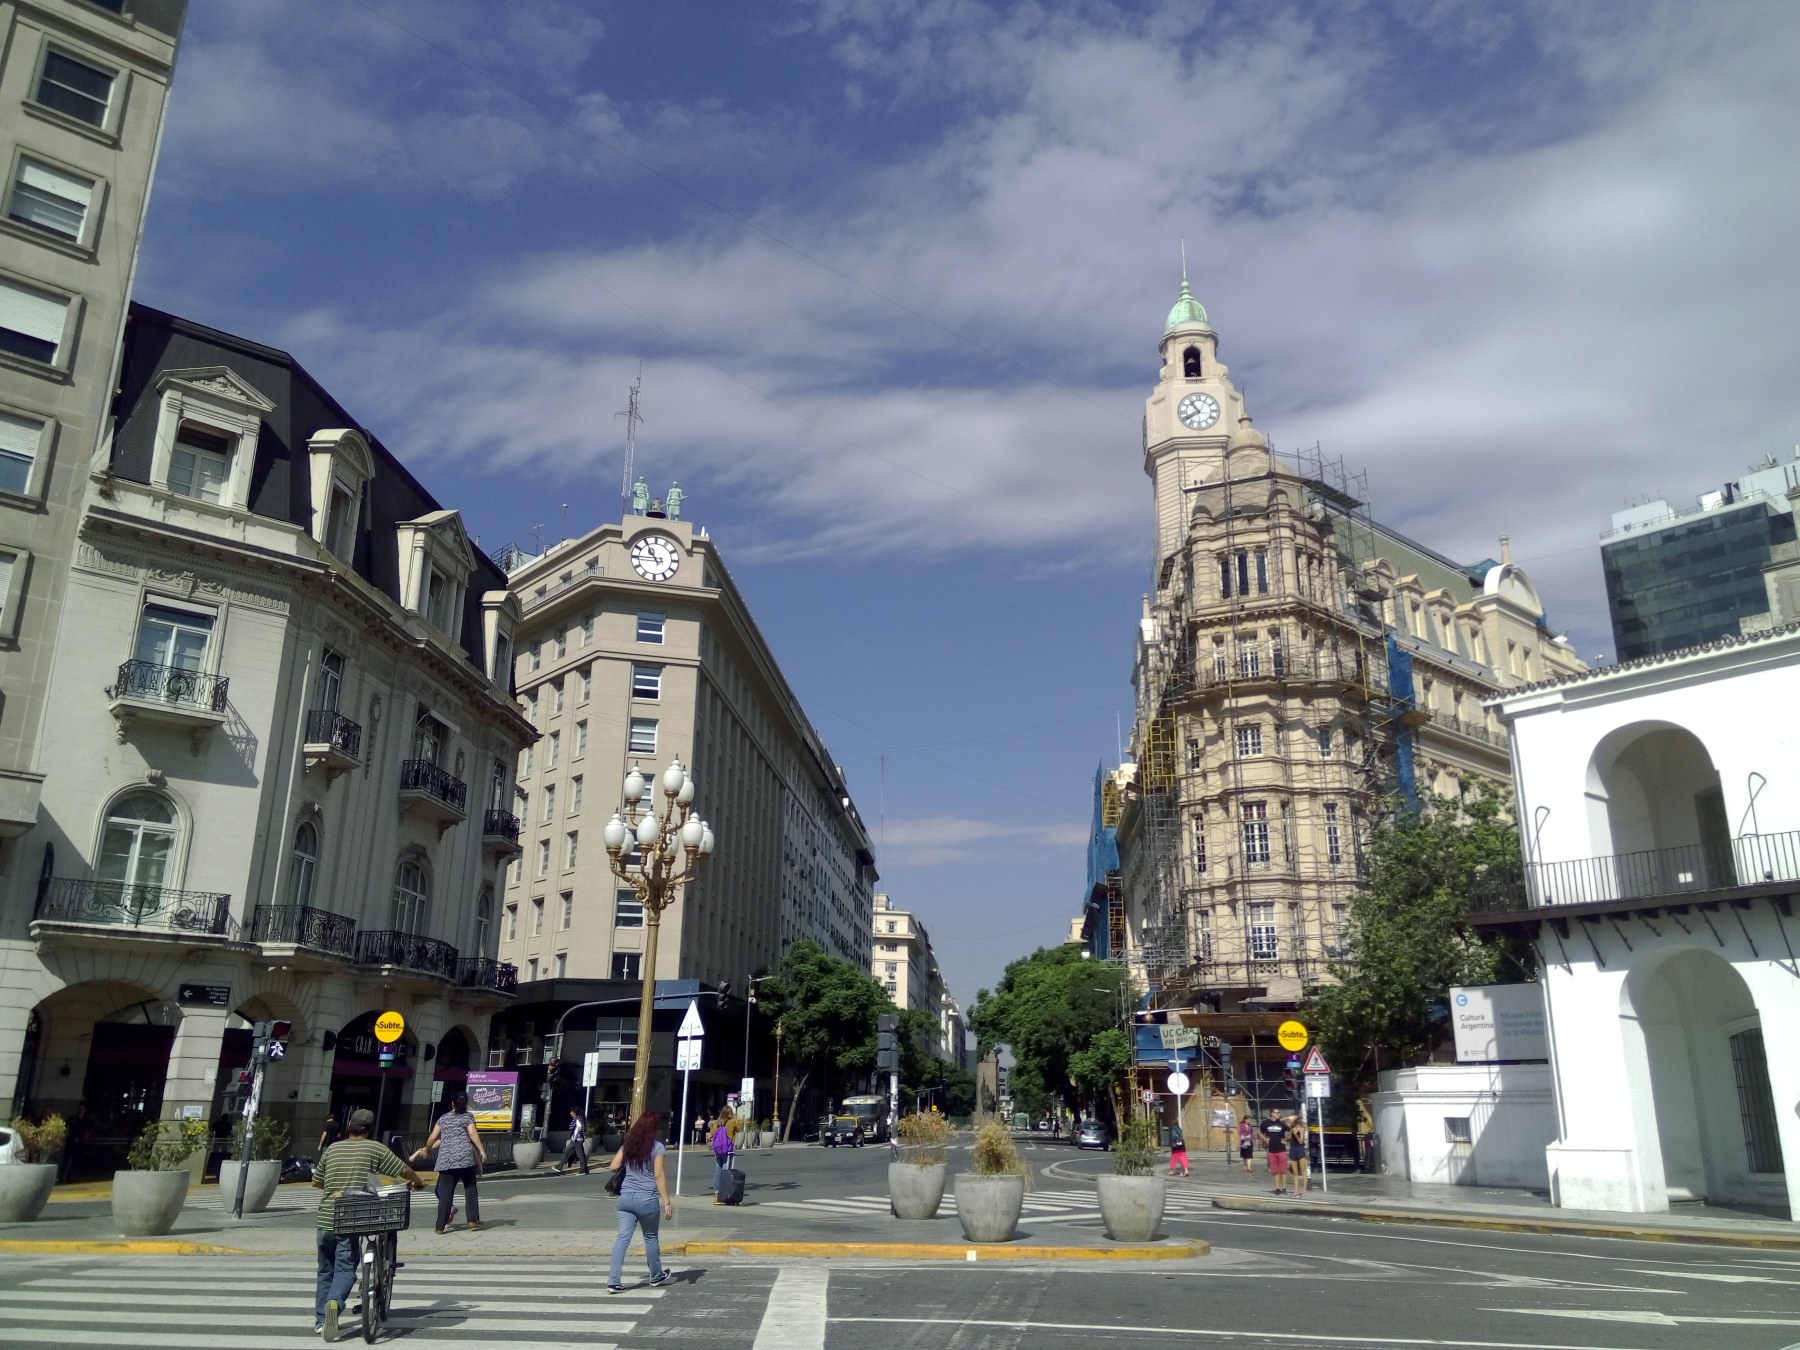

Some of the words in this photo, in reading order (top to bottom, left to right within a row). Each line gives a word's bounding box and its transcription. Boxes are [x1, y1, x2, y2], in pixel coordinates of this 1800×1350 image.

[1459, 1014, 1486, 1022] Cultura
[379, 1021, 401, 1029] Subte
[1461, 1022, 1495, 1031] Argentina
